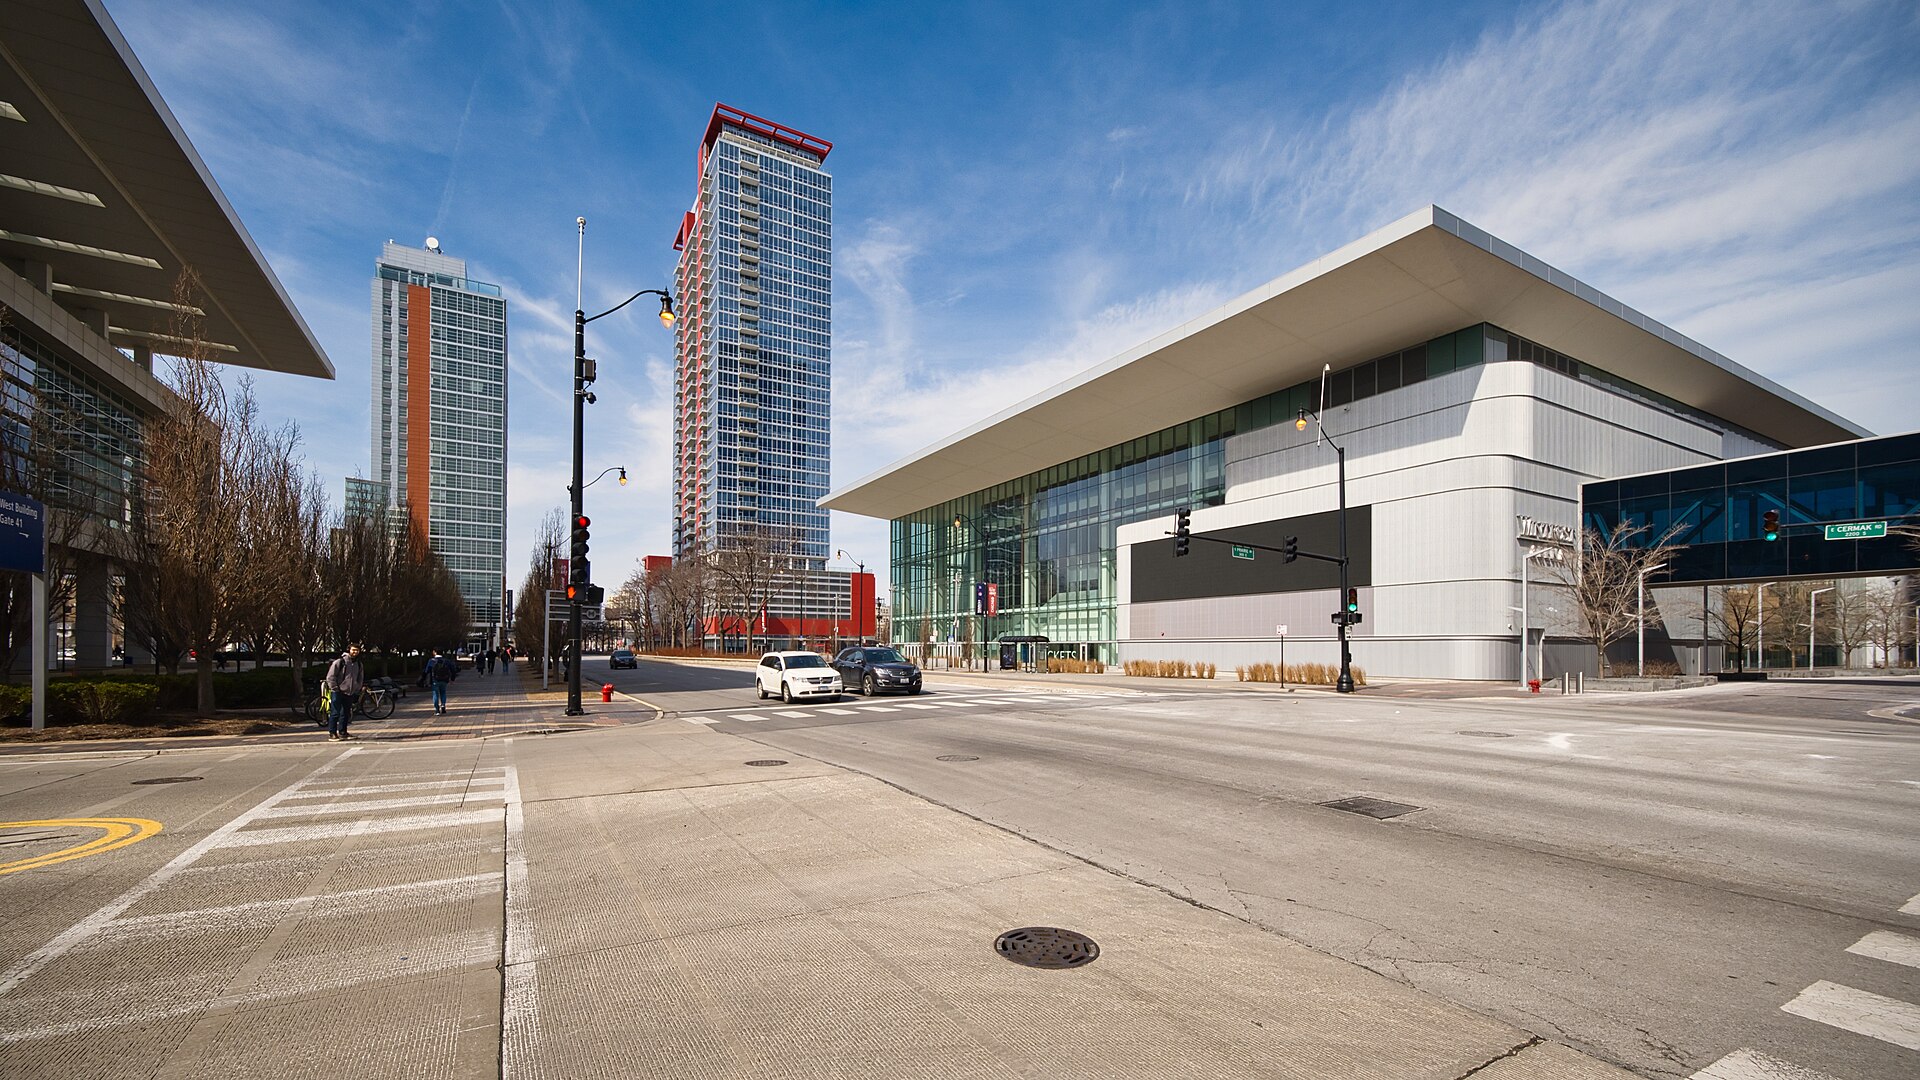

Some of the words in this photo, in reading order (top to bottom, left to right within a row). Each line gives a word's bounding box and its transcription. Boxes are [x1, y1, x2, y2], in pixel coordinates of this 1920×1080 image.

[0, 498, 14, 511] West
[15, 502, 38, 520] Building
[0, 513, 14, 526] Gate
[15, 517, 23, 528] 41
[1837, 525, 1872, 533] CERMAK
